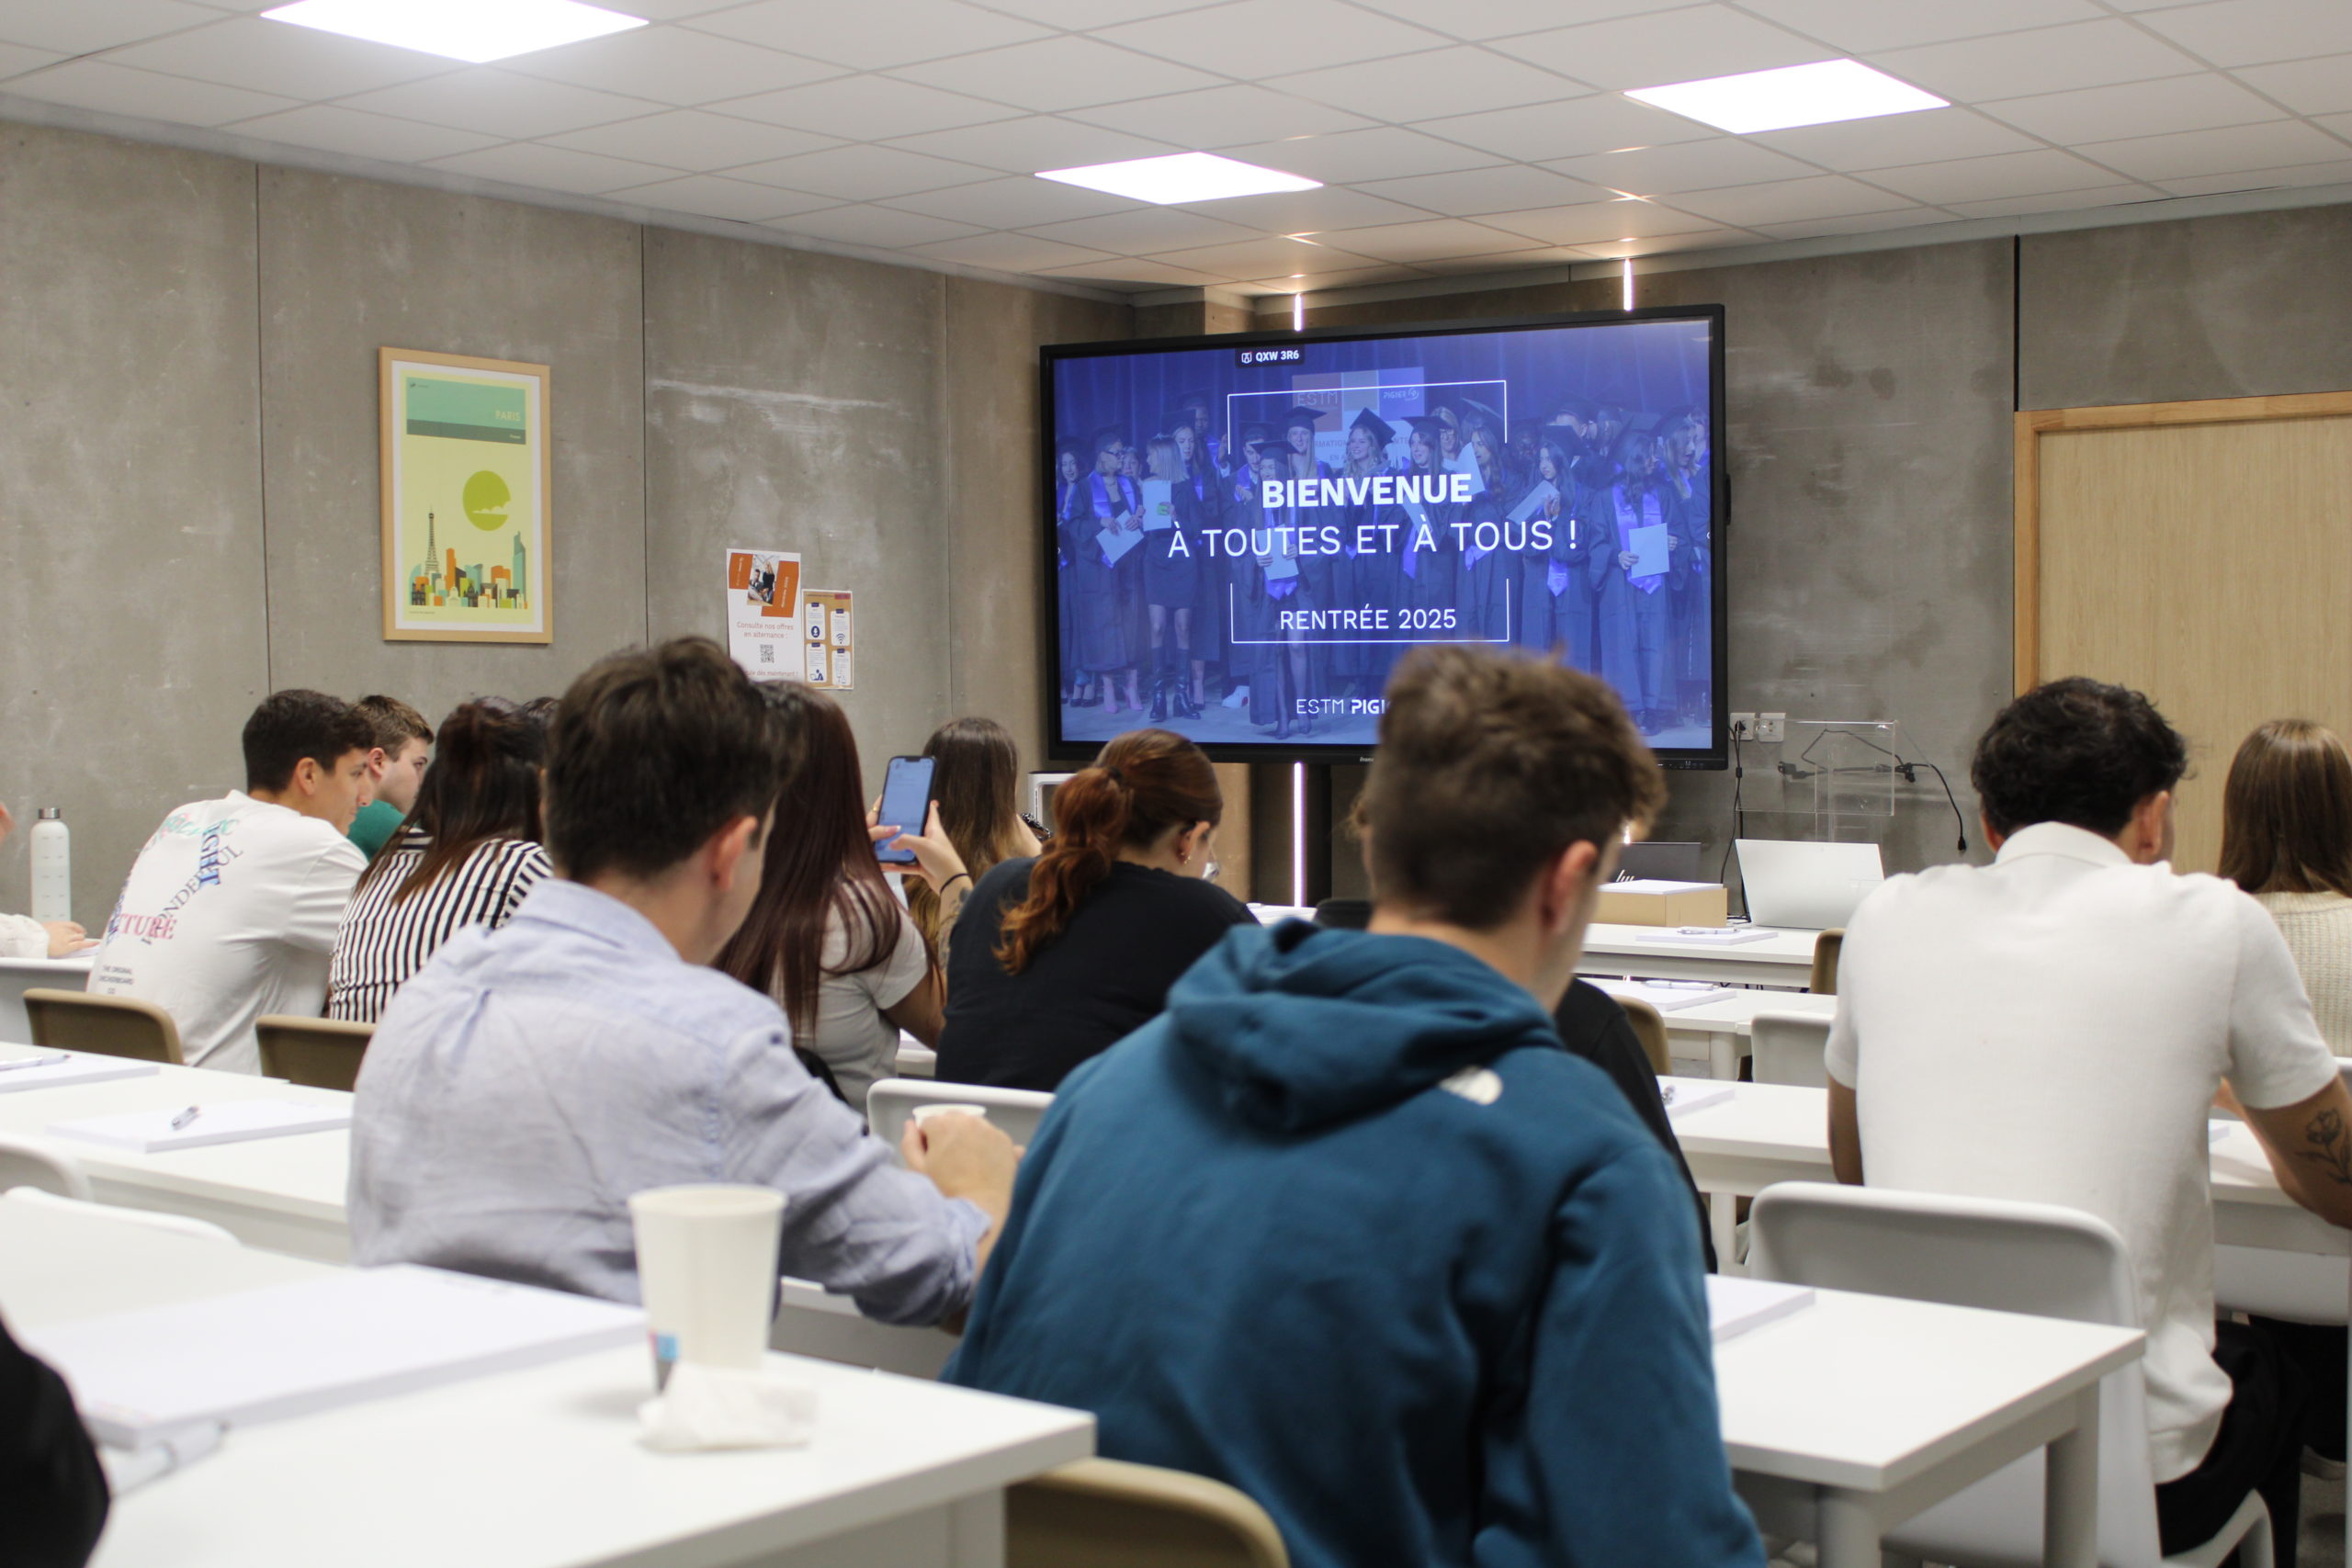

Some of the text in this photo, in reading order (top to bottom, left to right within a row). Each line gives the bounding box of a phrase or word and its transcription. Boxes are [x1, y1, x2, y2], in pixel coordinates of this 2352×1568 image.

[1255, 349, 1300, 363] QXW 3R6
[1297, 389, 1339, 405] ESTM
[494, 410, 521, 423] PARIS
[1262, 473, 1473, 508] BIENVENUE
[1168, 513, 1577, 558] À TOUTES ET À TOUS !
[736, 621, 763, 629] Consulte
[1280, 604, 1457, 630] RENTRÉE 2025
[1296, 699, 1385, 715] ESTM PIGI
